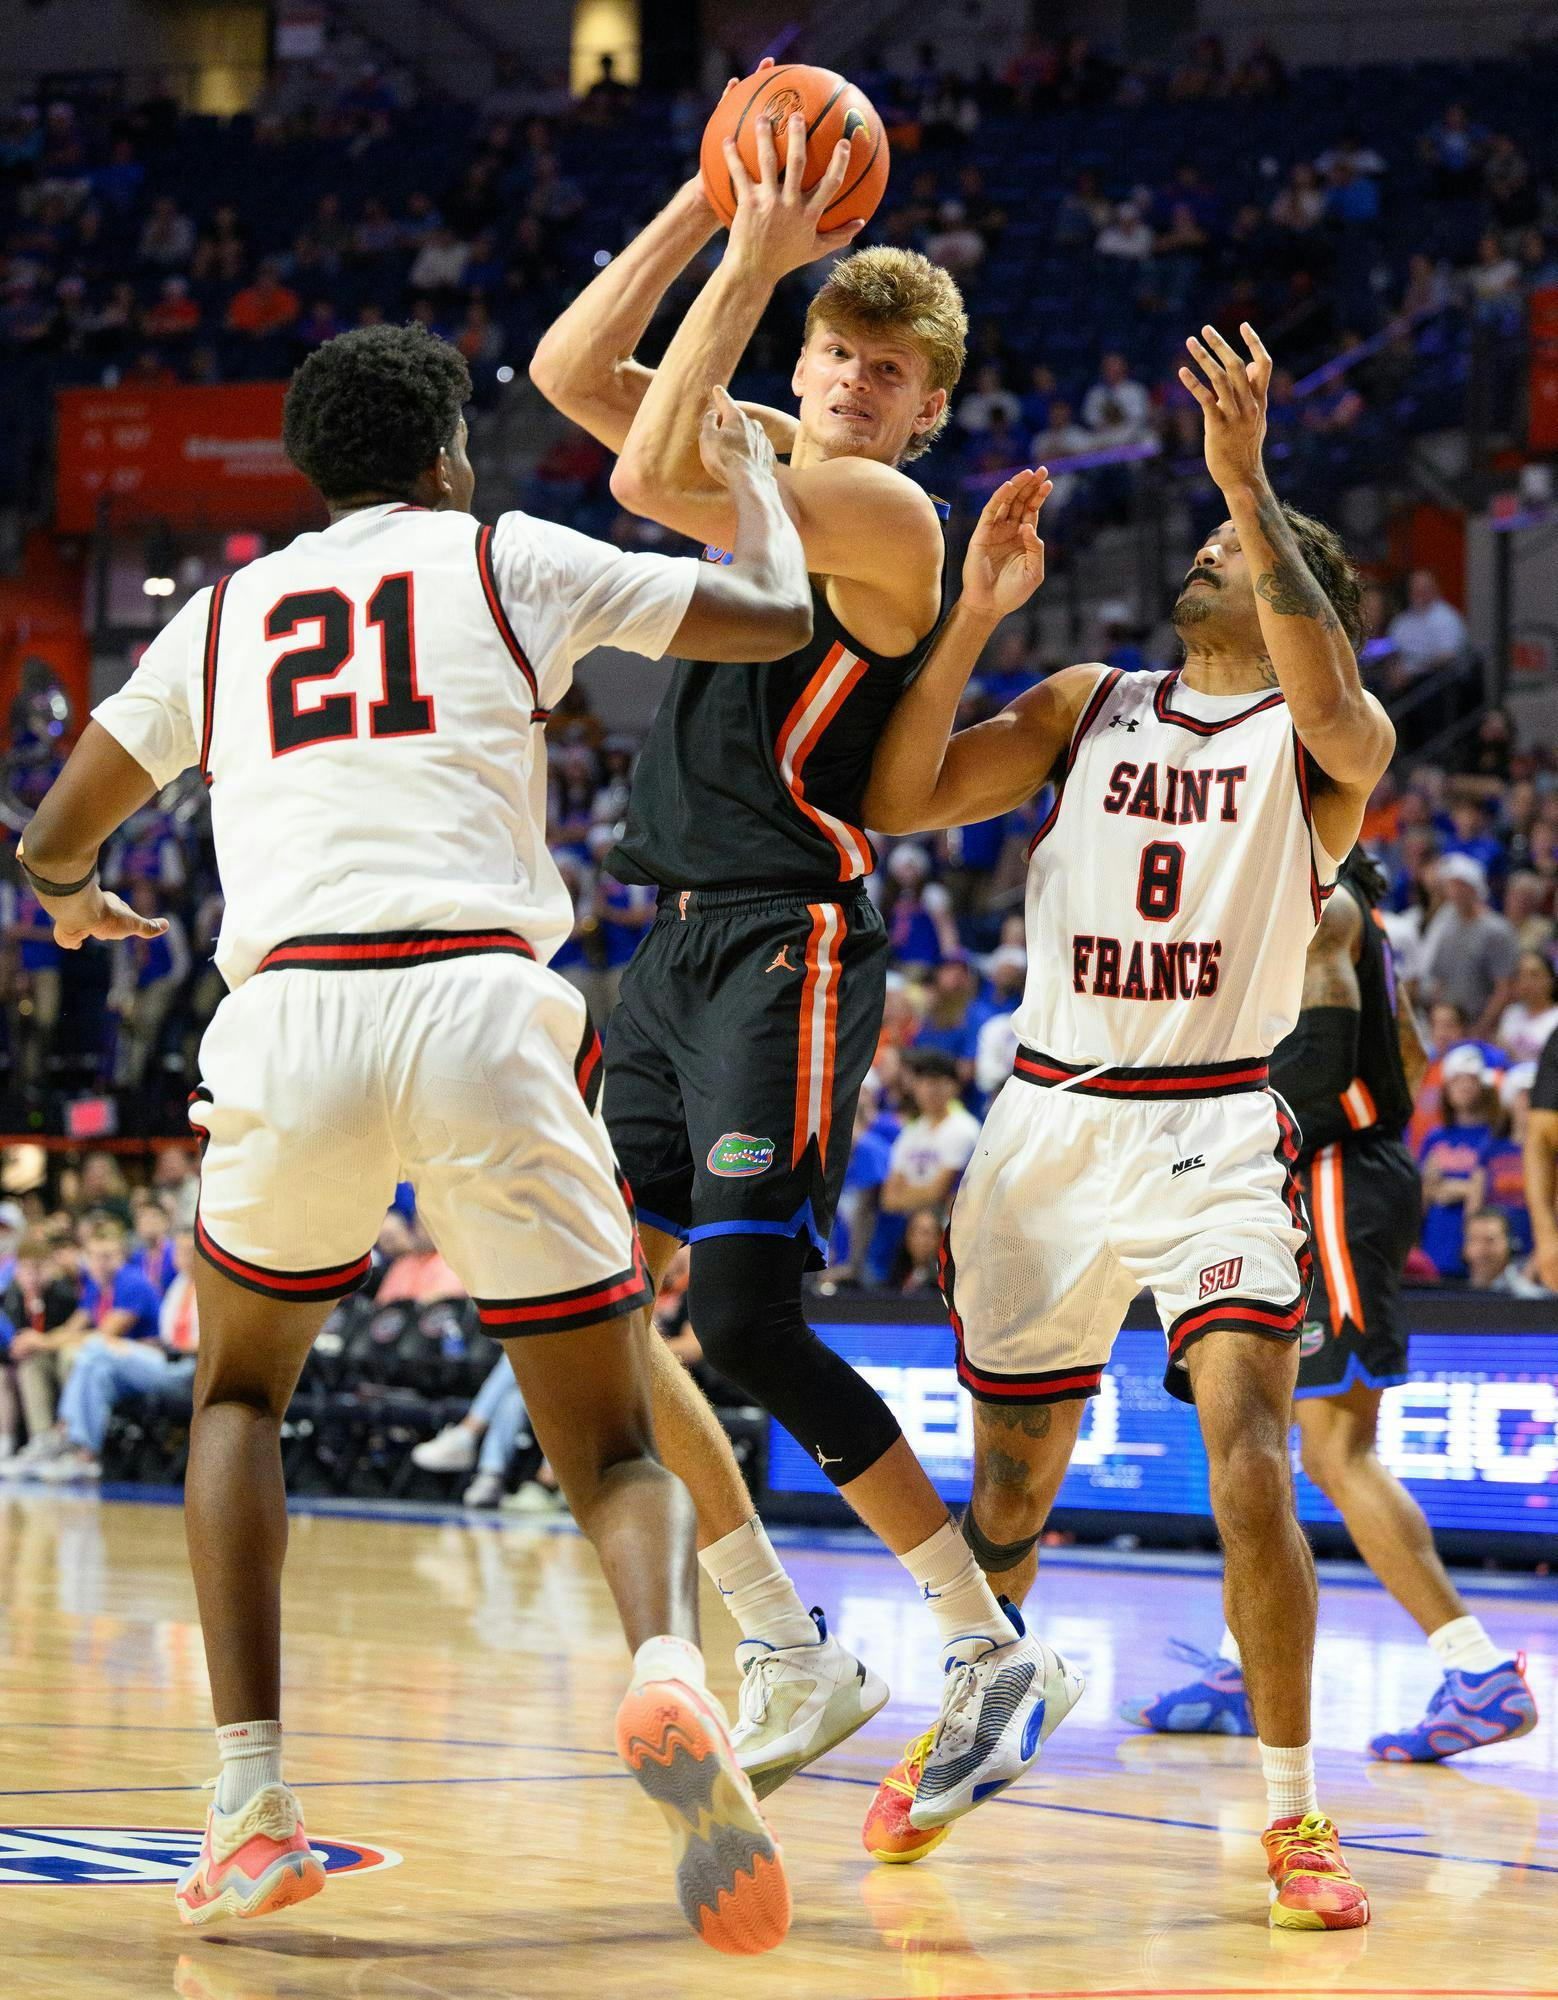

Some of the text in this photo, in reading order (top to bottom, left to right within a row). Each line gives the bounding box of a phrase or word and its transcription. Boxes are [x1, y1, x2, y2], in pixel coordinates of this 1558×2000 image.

[264, 570, 437, 759] 21
[1103, 760, 1247, 825] SAINT
[1135, 840, 1186, 922] 8
[1171, 1154, 1206, 1176] NEC
[1199, 1256, 1244, 1300] SFU
